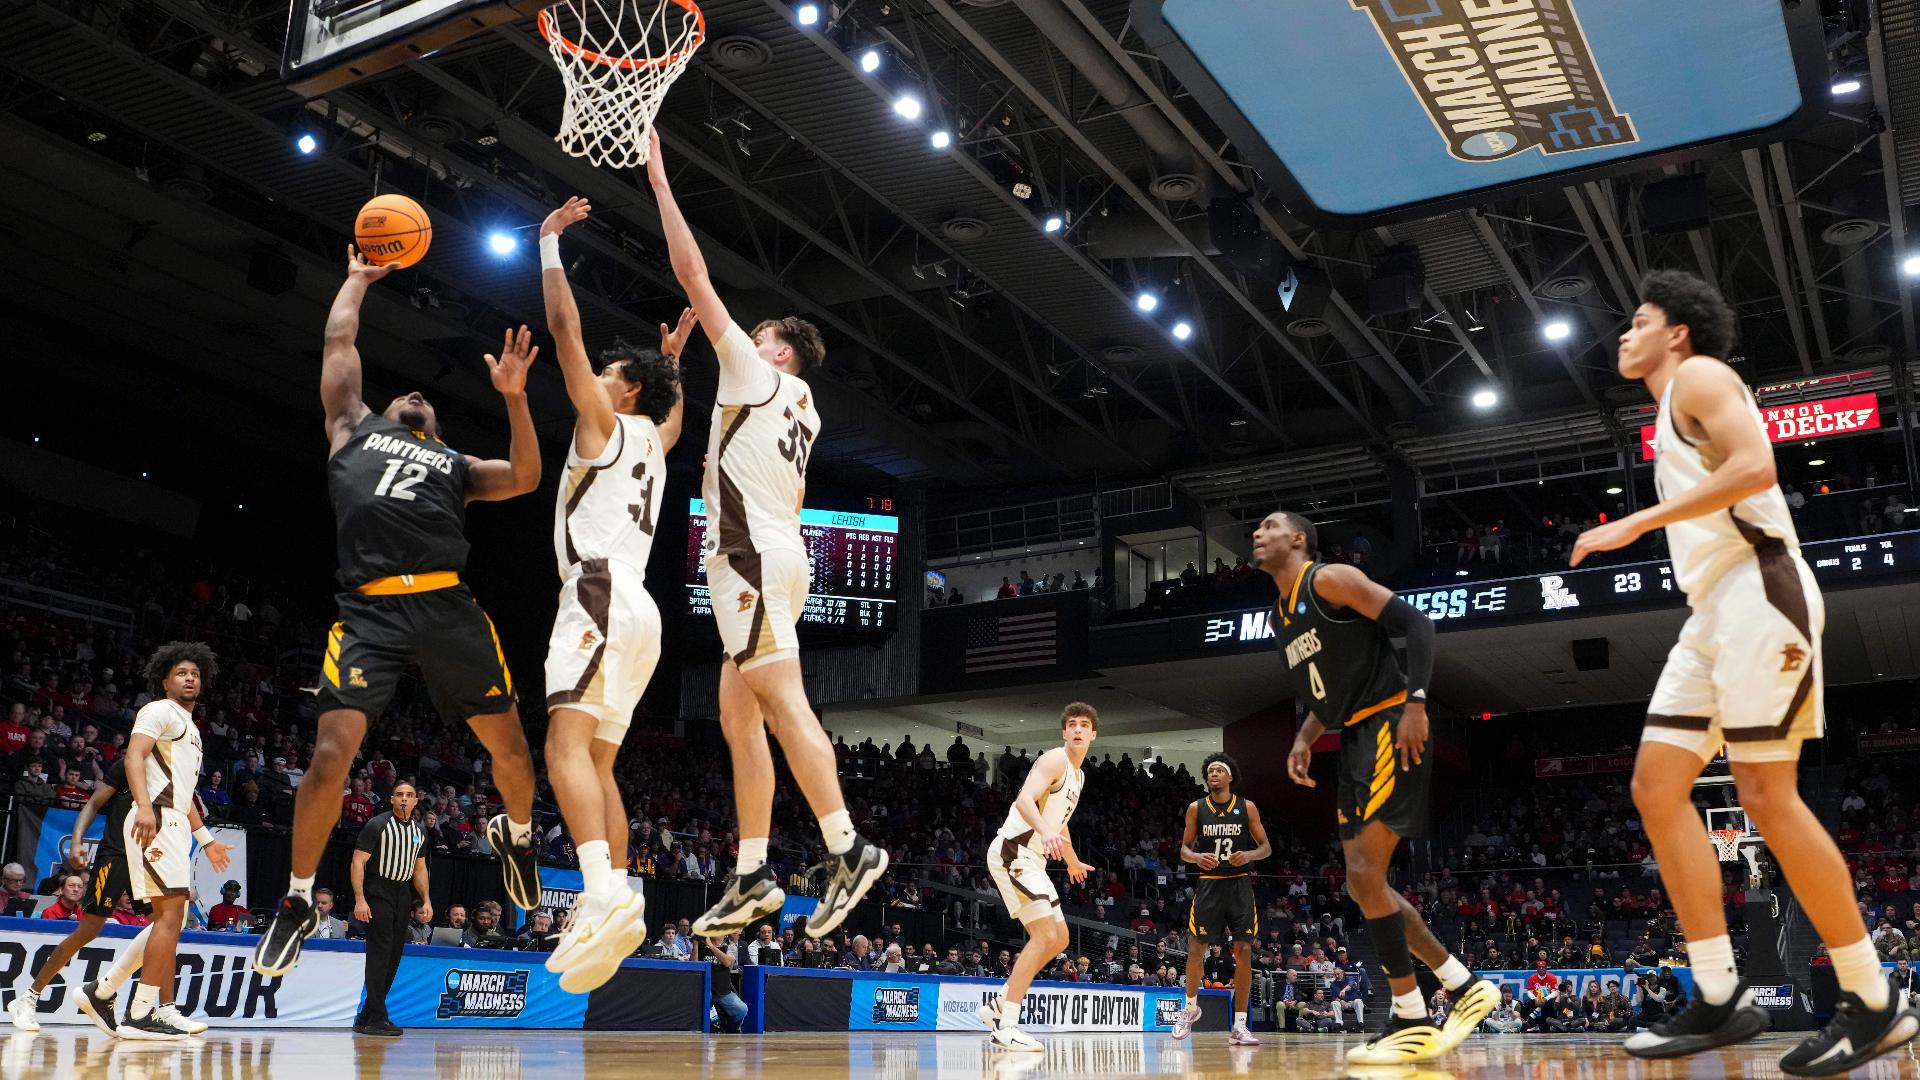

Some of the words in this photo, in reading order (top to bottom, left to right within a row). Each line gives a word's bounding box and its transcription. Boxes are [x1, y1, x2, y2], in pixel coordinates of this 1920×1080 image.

[1397, 23, 1514, 133] MARCH
[1776, 410, 1856, 438] DECK
[363, 432, 454, 475] PANTHERS
[374, 458, 428, 500] 12
[831, 515, 866, 527] LEHIGH
[802, 529, 823, 537] PLAYER
[1844, 544, 1867, 552] FOULS
[1817, 558, 1839, 567] BONUS
[1852, 558, 1862, 570] 2
[1884, 553, 1894, 566] 4
[1614, 572, 1642, 593] 23
[1662, 578, 1671, 591] 4
[860, 601, 870, 609] STL
[1308, 662, 1326, 700] 0
[1202, 824, 1242, 837] PANTHERS
[1214, 838, 1233, 862] 13
[121, 953, 278, 1018] OUR
[460, 974, 505, 992] MARCH
[464, 993, 524, 1010] MADNESS
[883, 991, 908, 1004] MARCH
[885, 1005, 918, 1017] MADNESS
[944, 1001, 968, 1012] HOSTED
[970, 1002, 978, 1012] BY
[1072, 995, 1089, 1025] OF
[1092, 995, 1140, 1026] DAYTON
